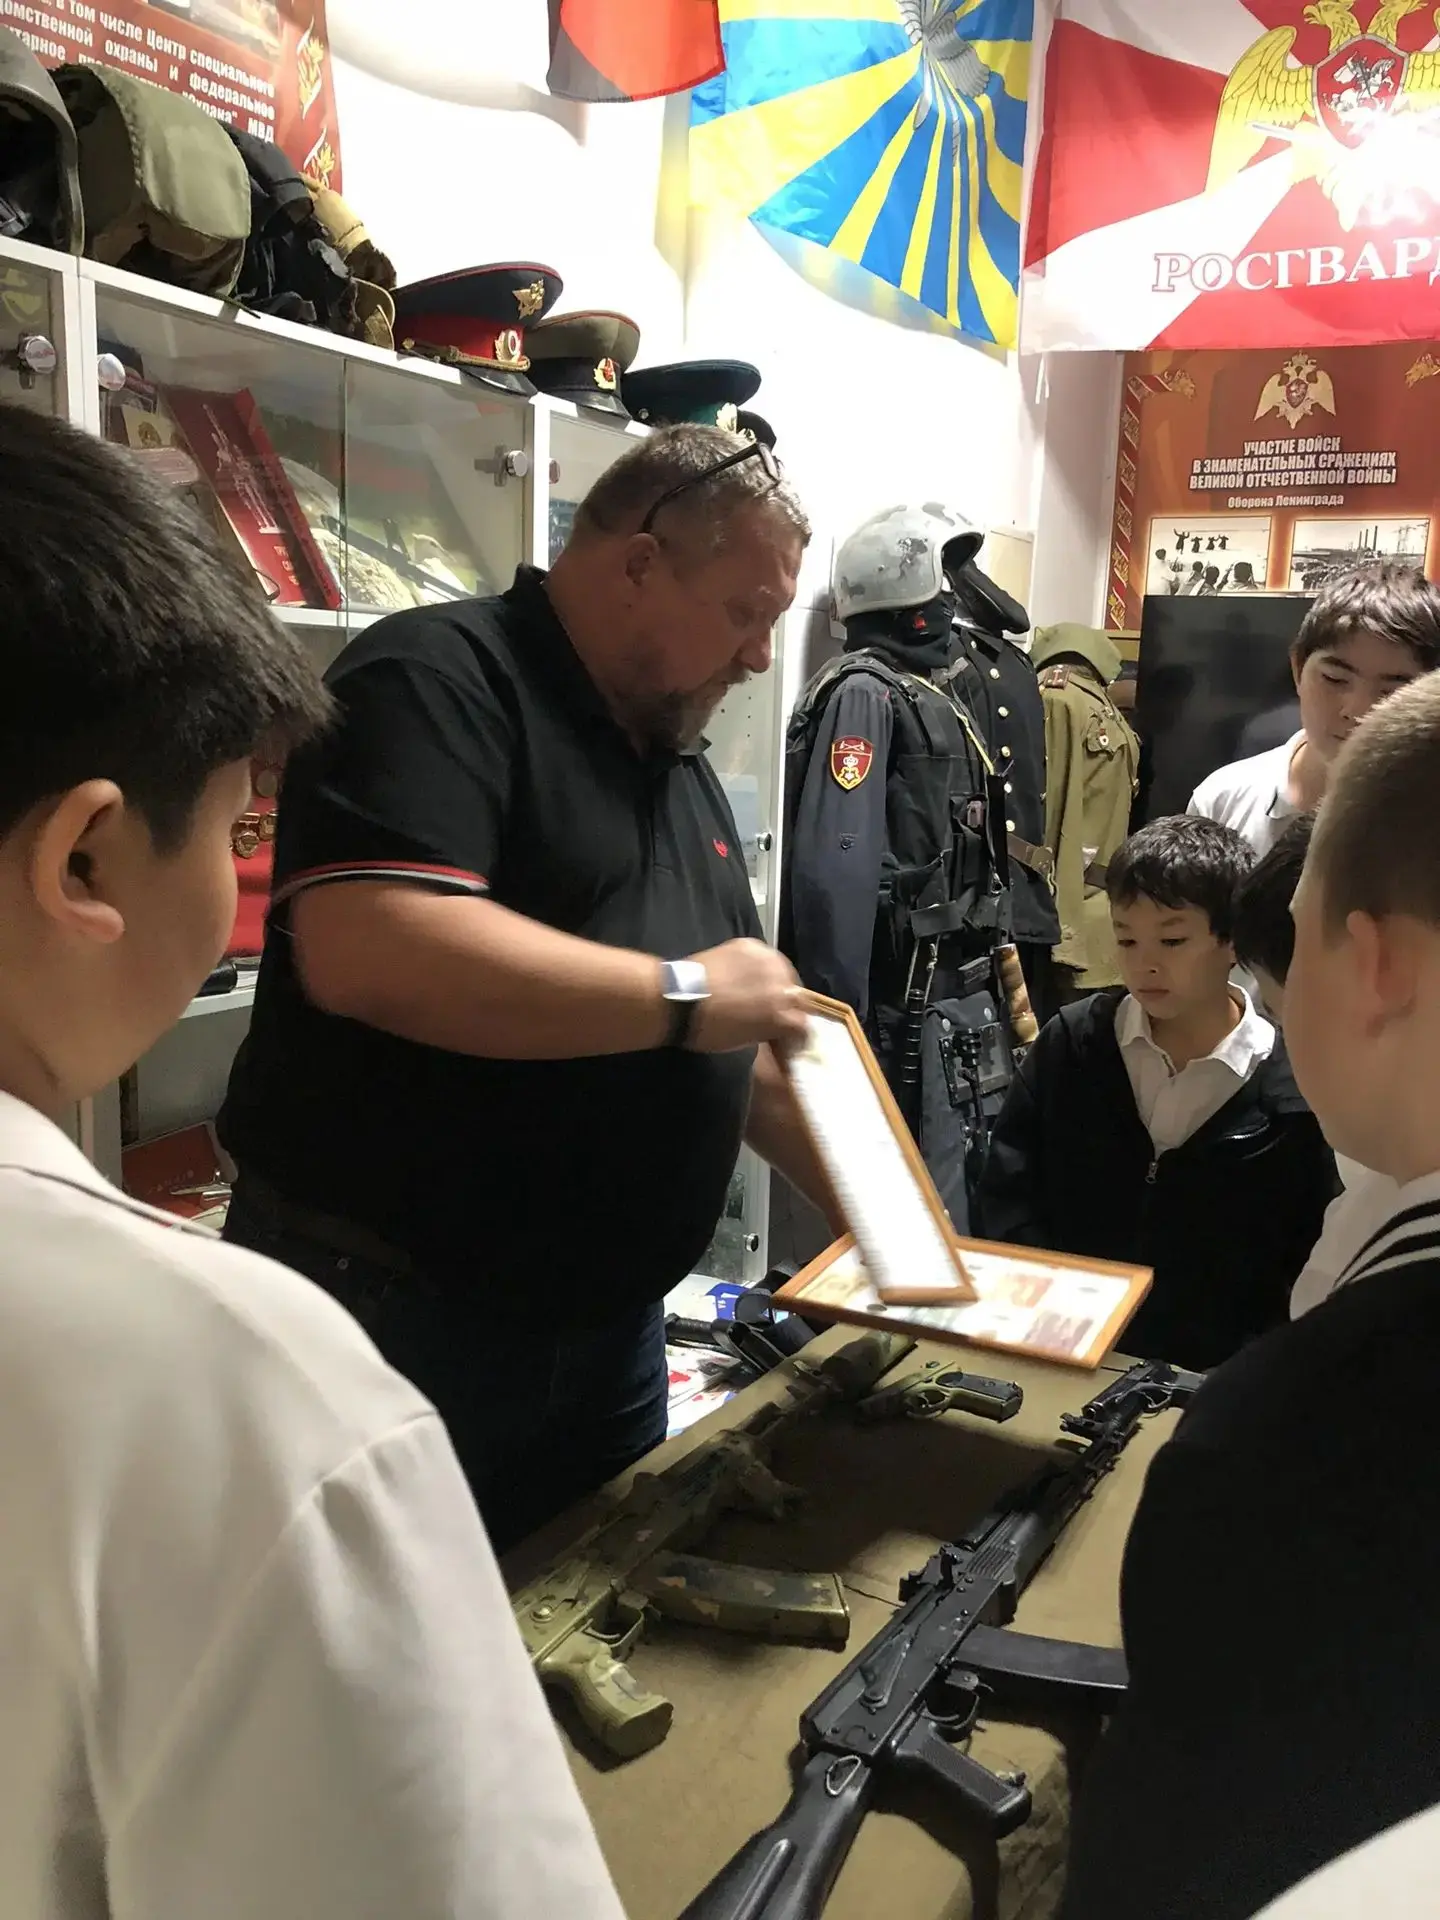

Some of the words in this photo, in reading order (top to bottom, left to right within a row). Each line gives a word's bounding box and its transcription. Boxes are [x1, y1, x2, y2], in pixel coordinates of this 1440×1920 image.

[69, 1, 96, 23] том
[100, 11, 143, 42] числе
[146, 28, 187, 61] Центр
[189, 48, 276, 98] специального
[105, 39, 158, 74] охраны
[168, 64, 179, 81] и
[188, 72, 276, 121] федеральное
[247, 117, 274, 144] МВД
[1244, 439, 1295, 456] УЧАСТИЕ
[1297, 436, 1341, 454] ВОЙСК
[1193, 459, 1203, 473] В
[1203, 454, 1316, 473] ЗНАМЕНАТЕЛЬНЫХ
[1318, 452, 1397, 468] СРАЖЕНИЯХ
[1189, 472, 1244, 489] ВЕЛИКОЙ
[1246, 467, 1345, 487] ОТЕЧЕСТВЕННОЙ
[1347, 466, 1397, 485] ВОЙНЫ
[1228, 496, 1274, 508] Оборона
[1275, 494, 1344, 507] Ленинграда
